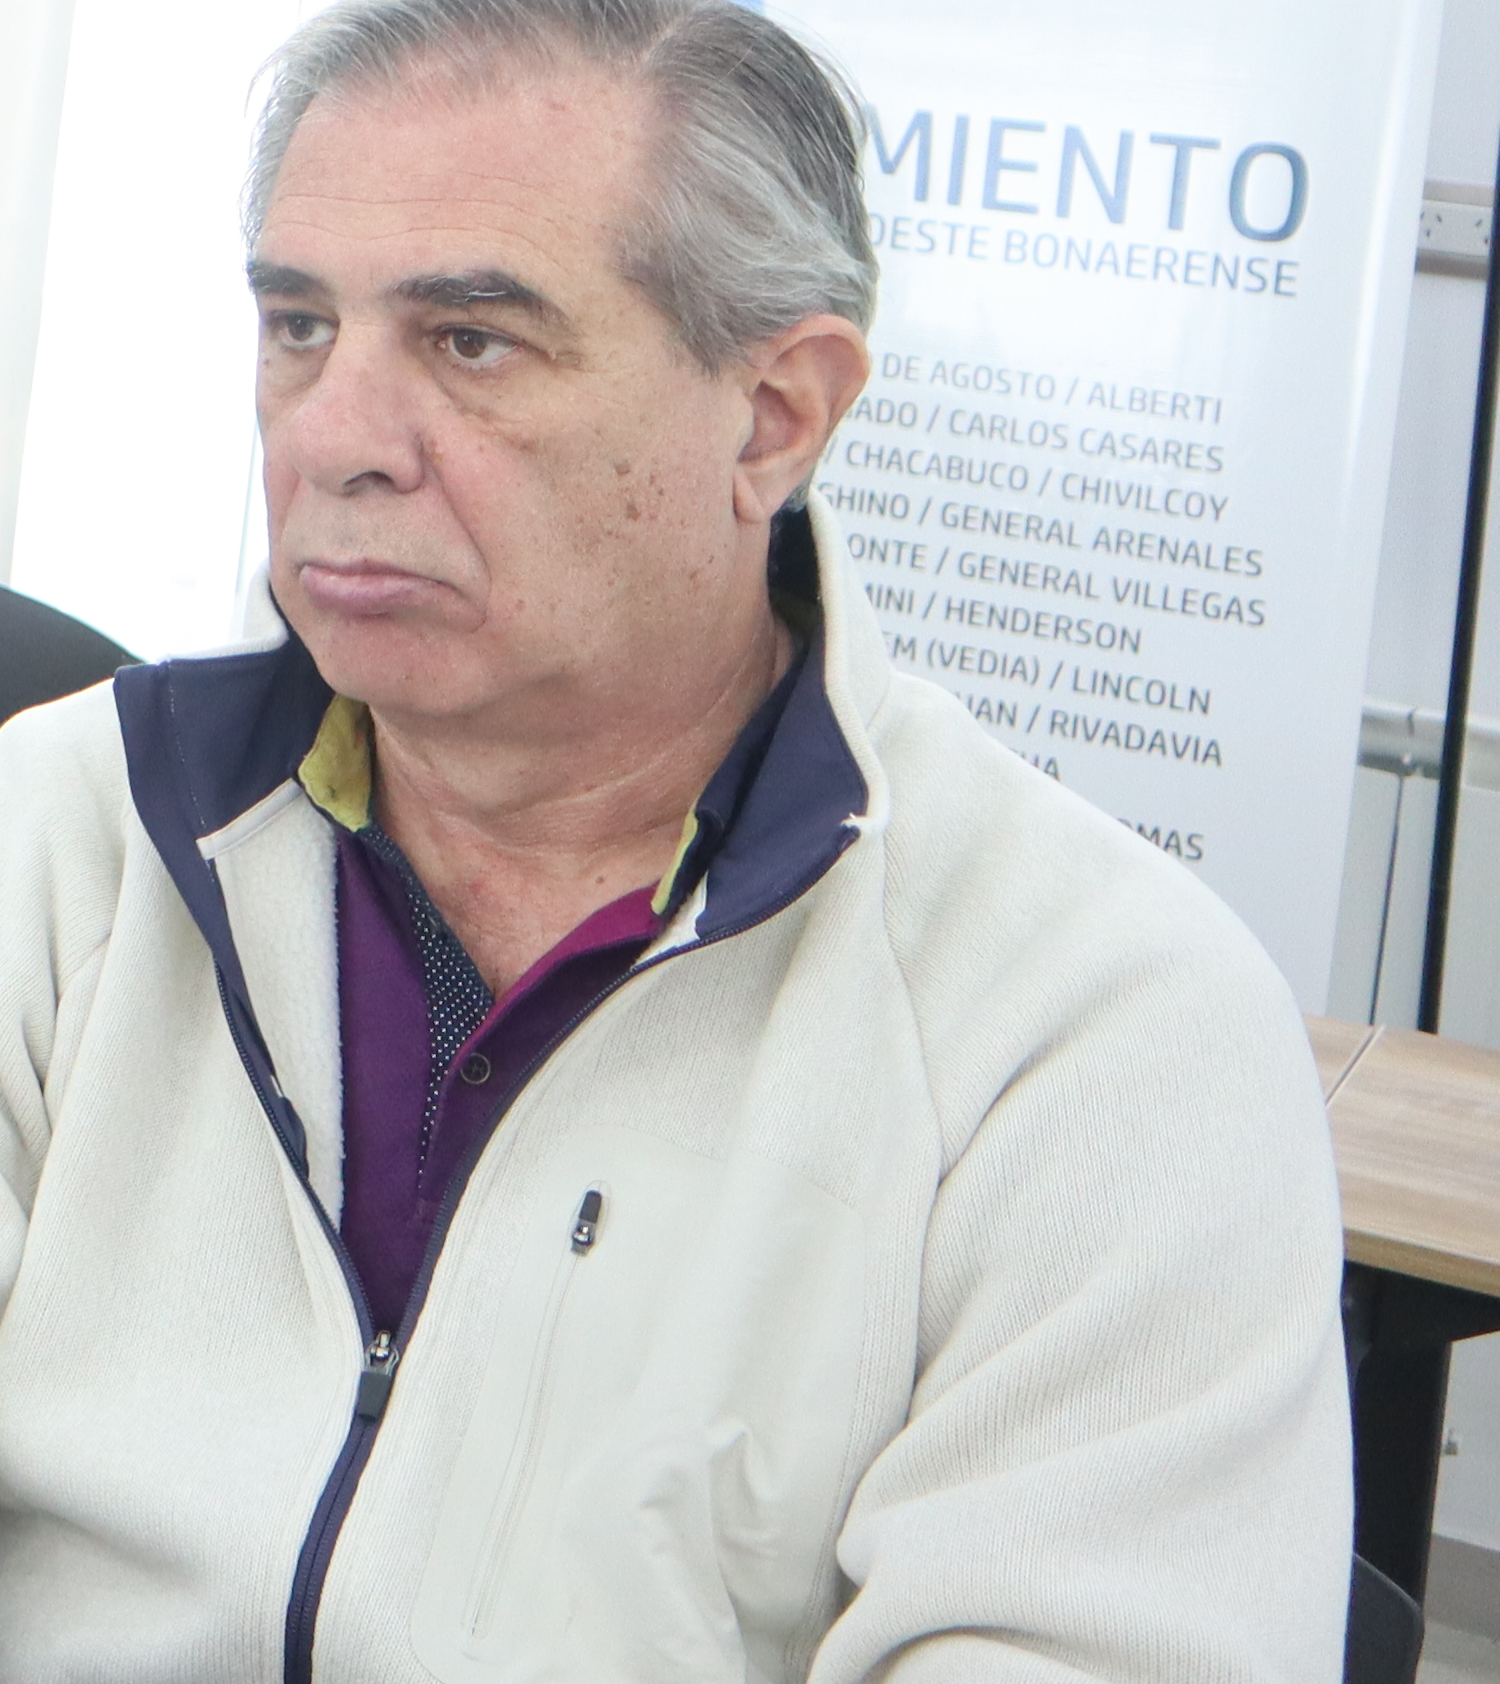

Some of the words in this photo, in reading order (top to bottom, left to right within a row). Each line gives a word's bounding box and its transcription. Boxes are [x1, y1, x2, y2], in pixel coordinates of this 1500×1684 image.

[1004, 227, 1299, 299] BONAERENSE
[882, 352, 921, 383] DE
[930, 358, 1057, 402] AGOSTO
[1087, 381, 1224, 425] ALBERTI
[846, 395, 918, 428] ADO
[948, 408, 1070, 451] CARLOS
[1078, 426, 1226, 474] CASARES
[845, 440, 1030, 492] CHACABUCO
[1061, 471, 1230, 523] CHIVILCOY
[940, 500, 1083, 550] GENERAL
[1092, 524, 1265, 577] ARENALES
[944, 596, 1143, 655] HENDERSON
[957, 551, 1102, 599] GENERAL
[1111, 575, 1267, 627] VILLEGAS
[926, 637, 1040, 687] (VEDIA)
[1071, 668, 1212, 715] LINCOLN
[1048, 708, 1224, 767] RIVADAVIA
